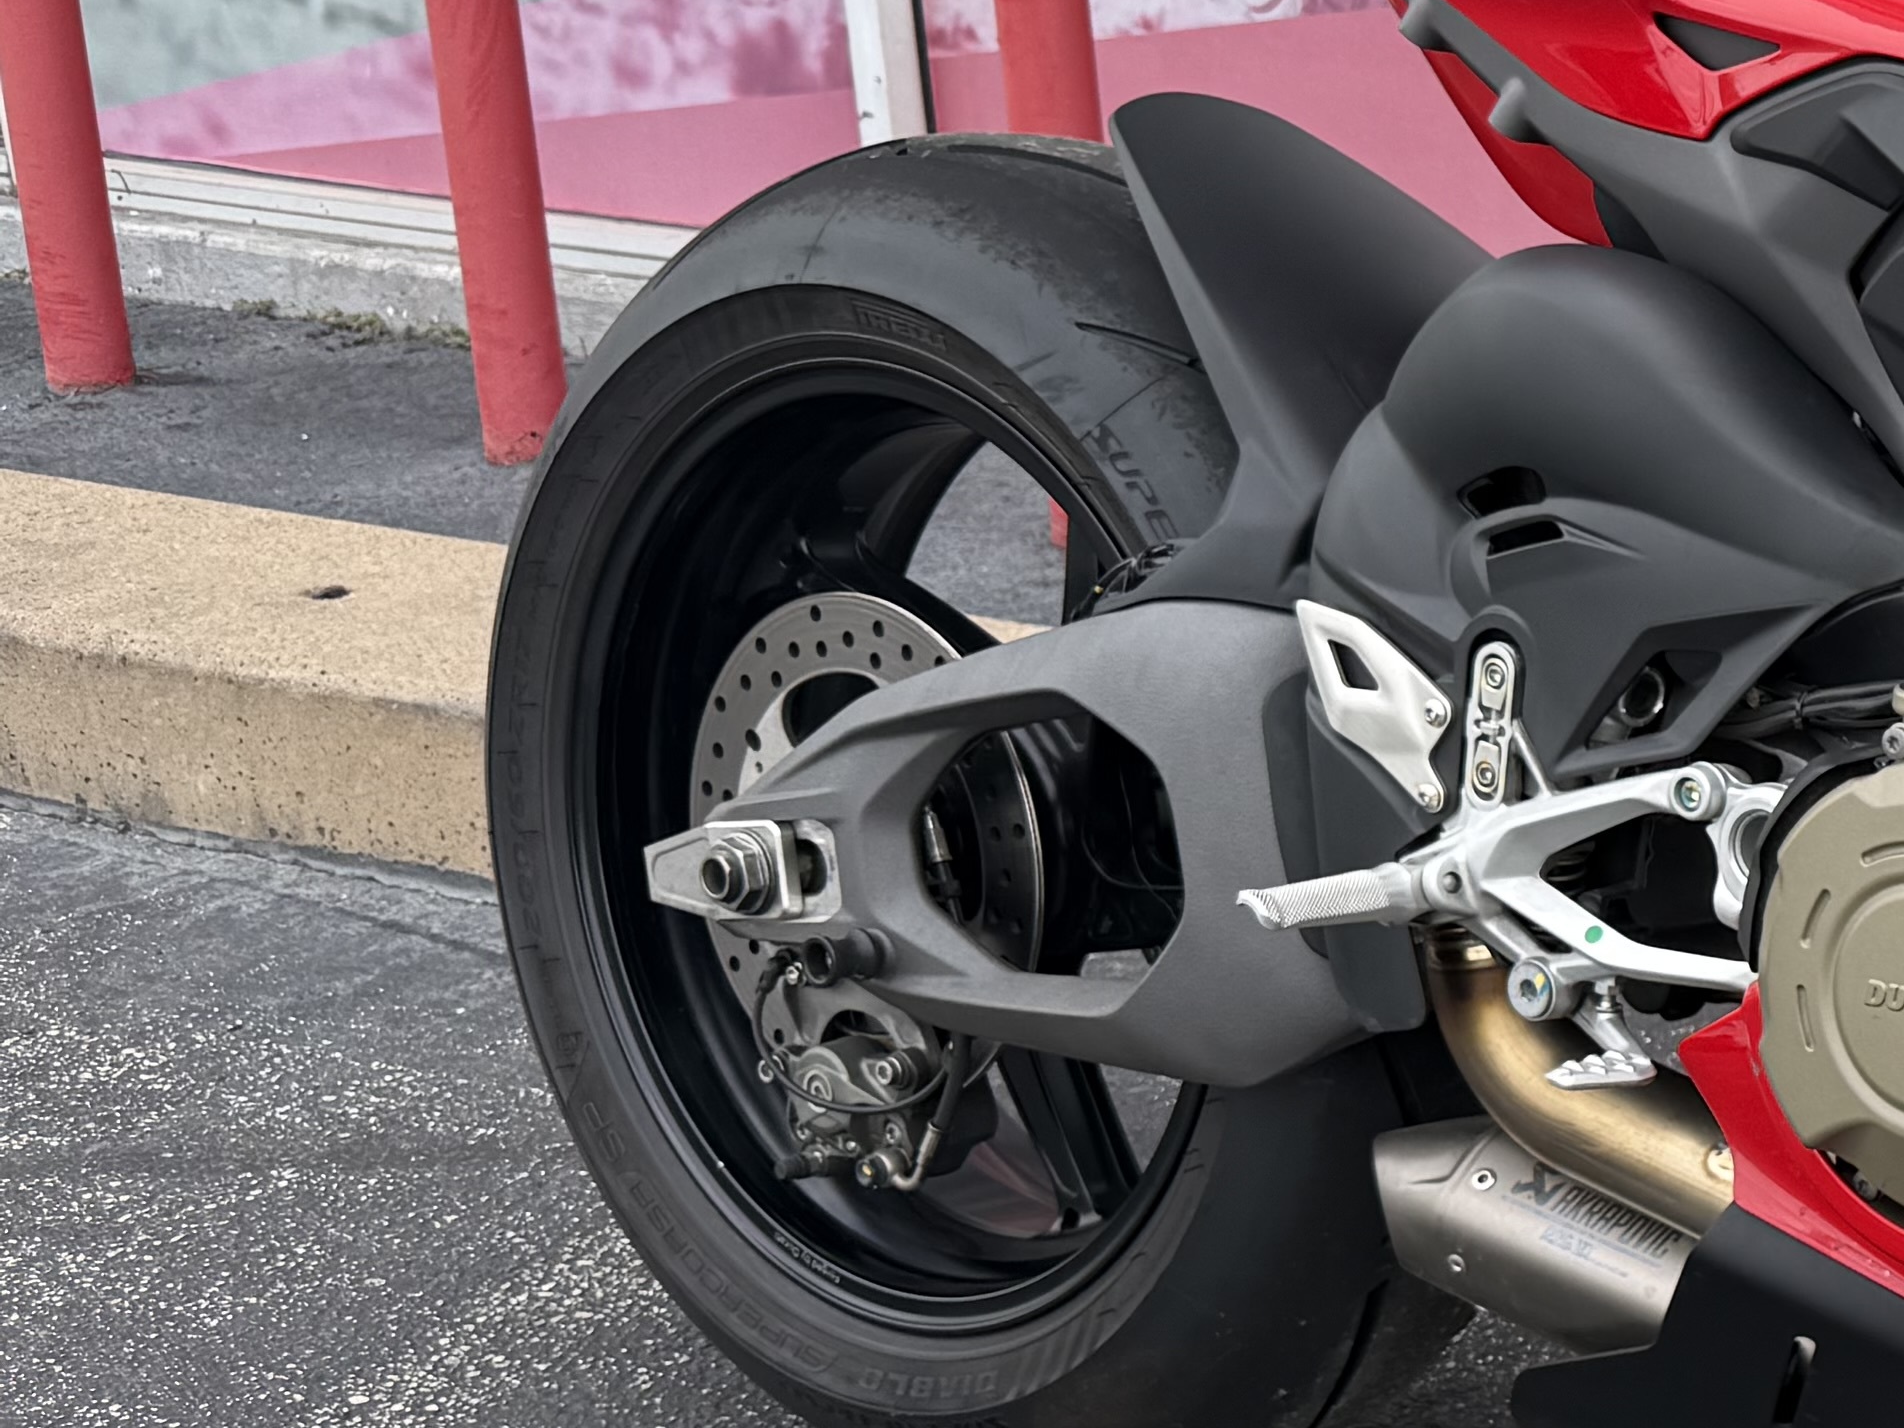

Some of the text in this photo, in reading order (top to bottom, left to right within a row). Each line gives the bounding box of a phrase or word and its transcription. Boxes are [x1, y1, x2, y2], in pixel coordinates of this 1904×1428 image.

[582, 1102, 627, 1164] SP
[628, 1179, 832, 1368] SUPERCORSA
[858, 1367, 999, 1398] DIABLO
